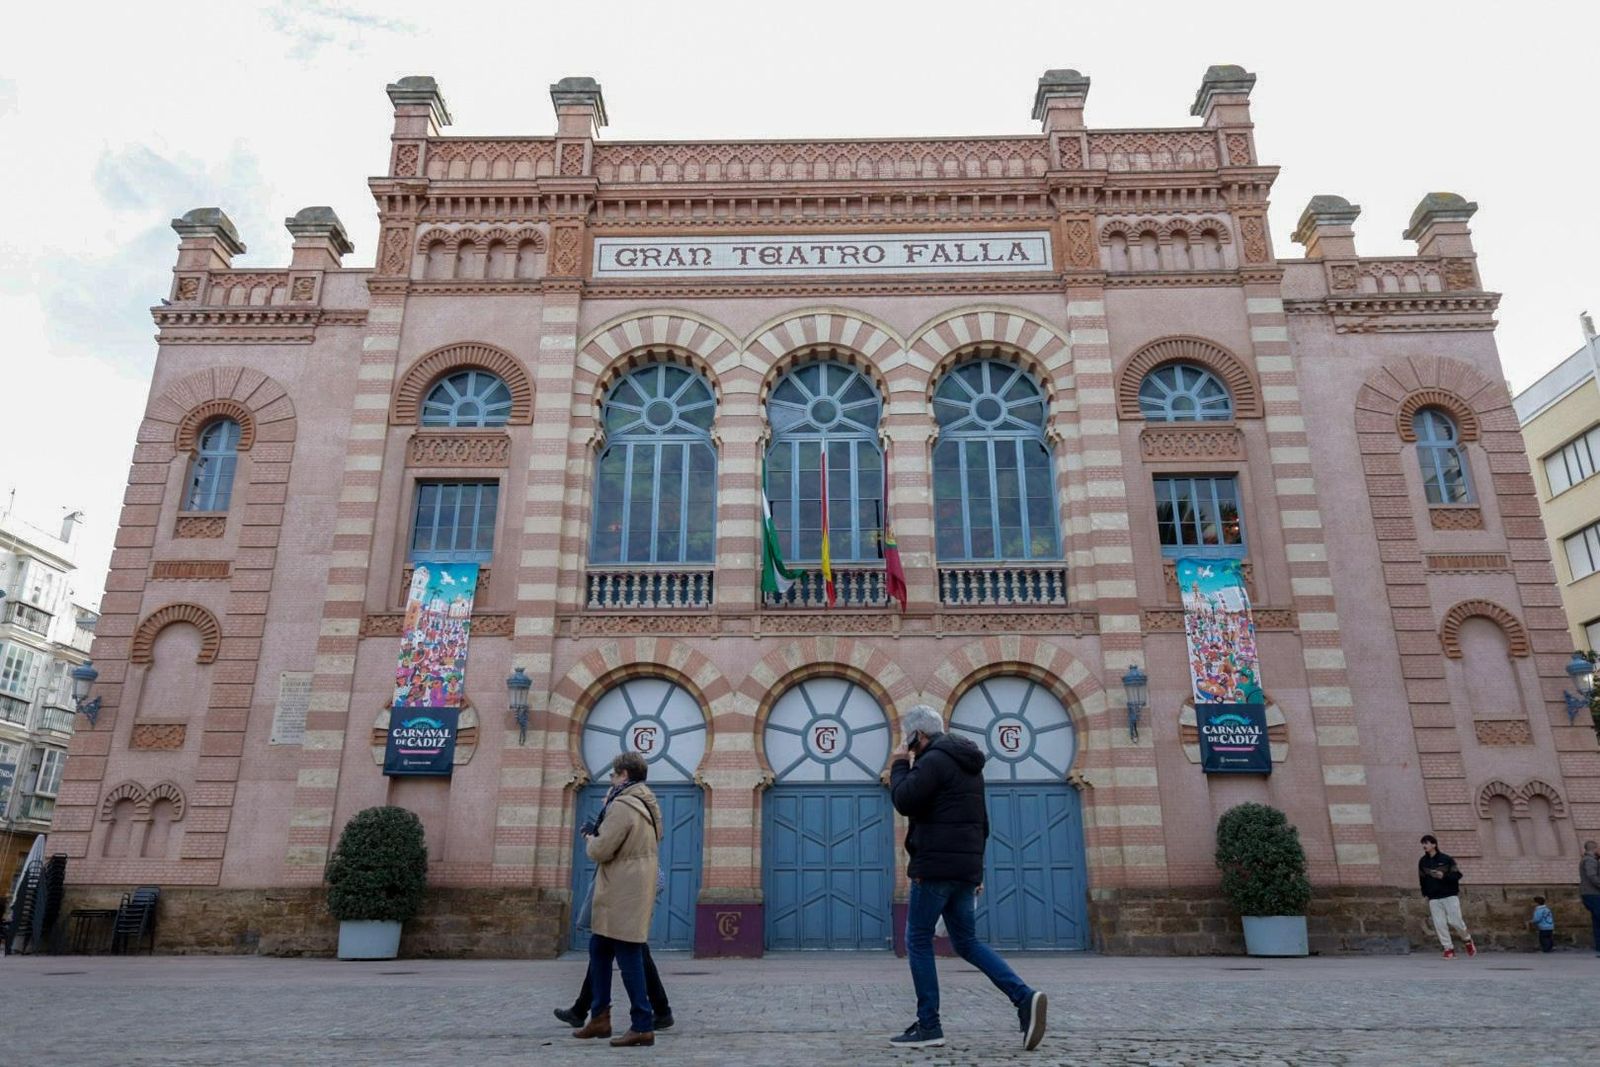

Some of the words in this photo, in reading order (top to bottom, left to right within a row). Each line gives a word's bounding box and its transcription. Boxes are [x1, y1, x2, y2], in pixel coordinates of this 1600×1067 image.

[615, 247, 712, 267] GRAN
[732, 244, 886, 267] TEATRO
[903, 242, 1030, 263] FALLA
[392, 728, 451, 738] CARNAVAL
[1202, 725, 1263, 735] CARNAVAL
[1208, 735, 1219, 743] DE
